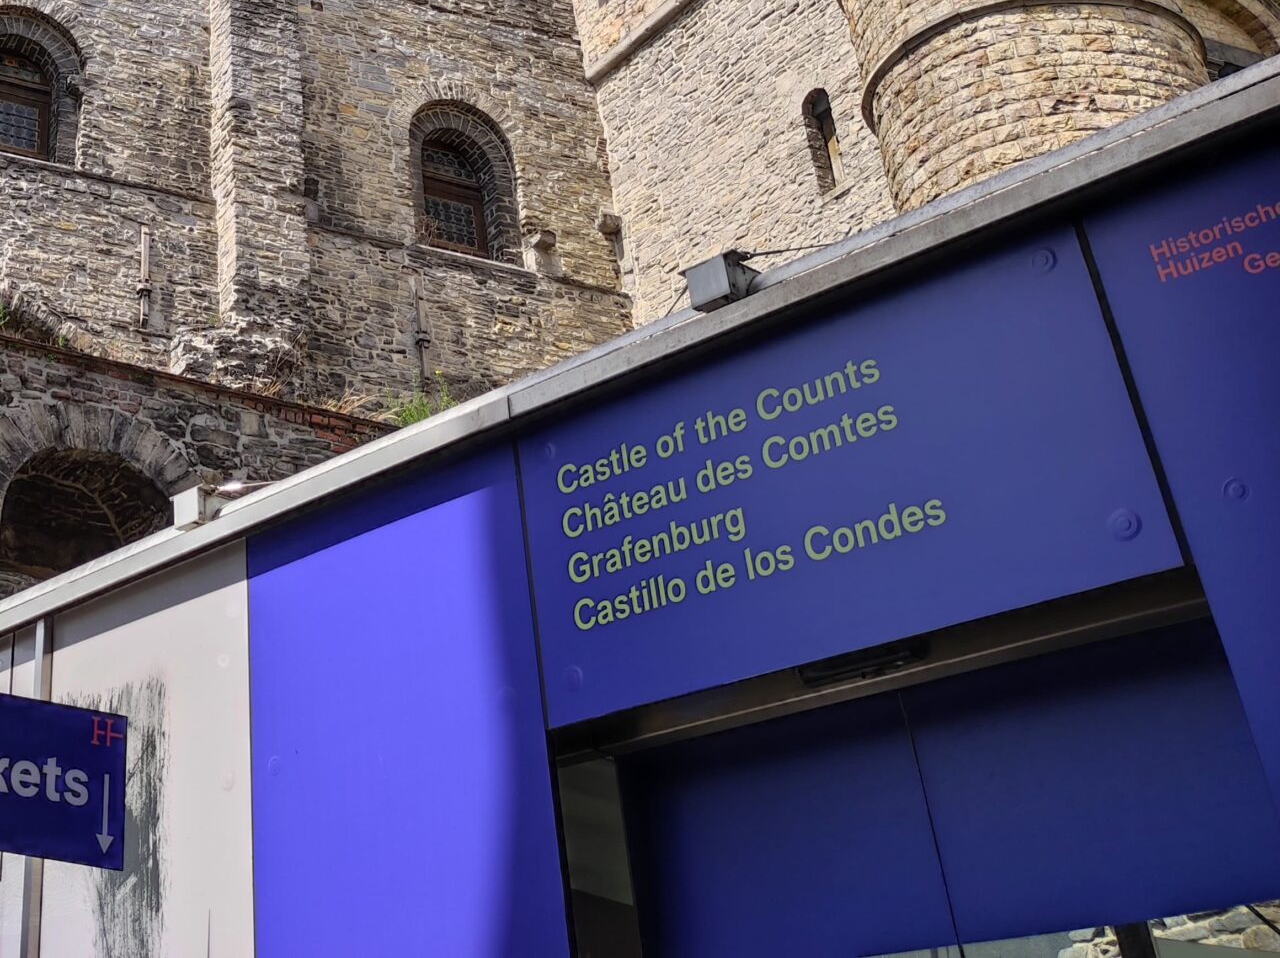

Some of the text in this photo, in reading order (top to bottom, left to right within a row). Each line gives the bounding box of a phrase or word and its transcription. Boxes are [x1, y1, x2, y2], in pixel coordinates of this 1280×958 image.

[1156, 241, 1243, 283] Huizen
[557, 359, 880, 493] Castle of the Counts
[562, 405, 898, 538] Château des Comtes
[568, 507, 746, 583] Grafenburg
[574, 498, 946, 630] Castillo de los Condes
